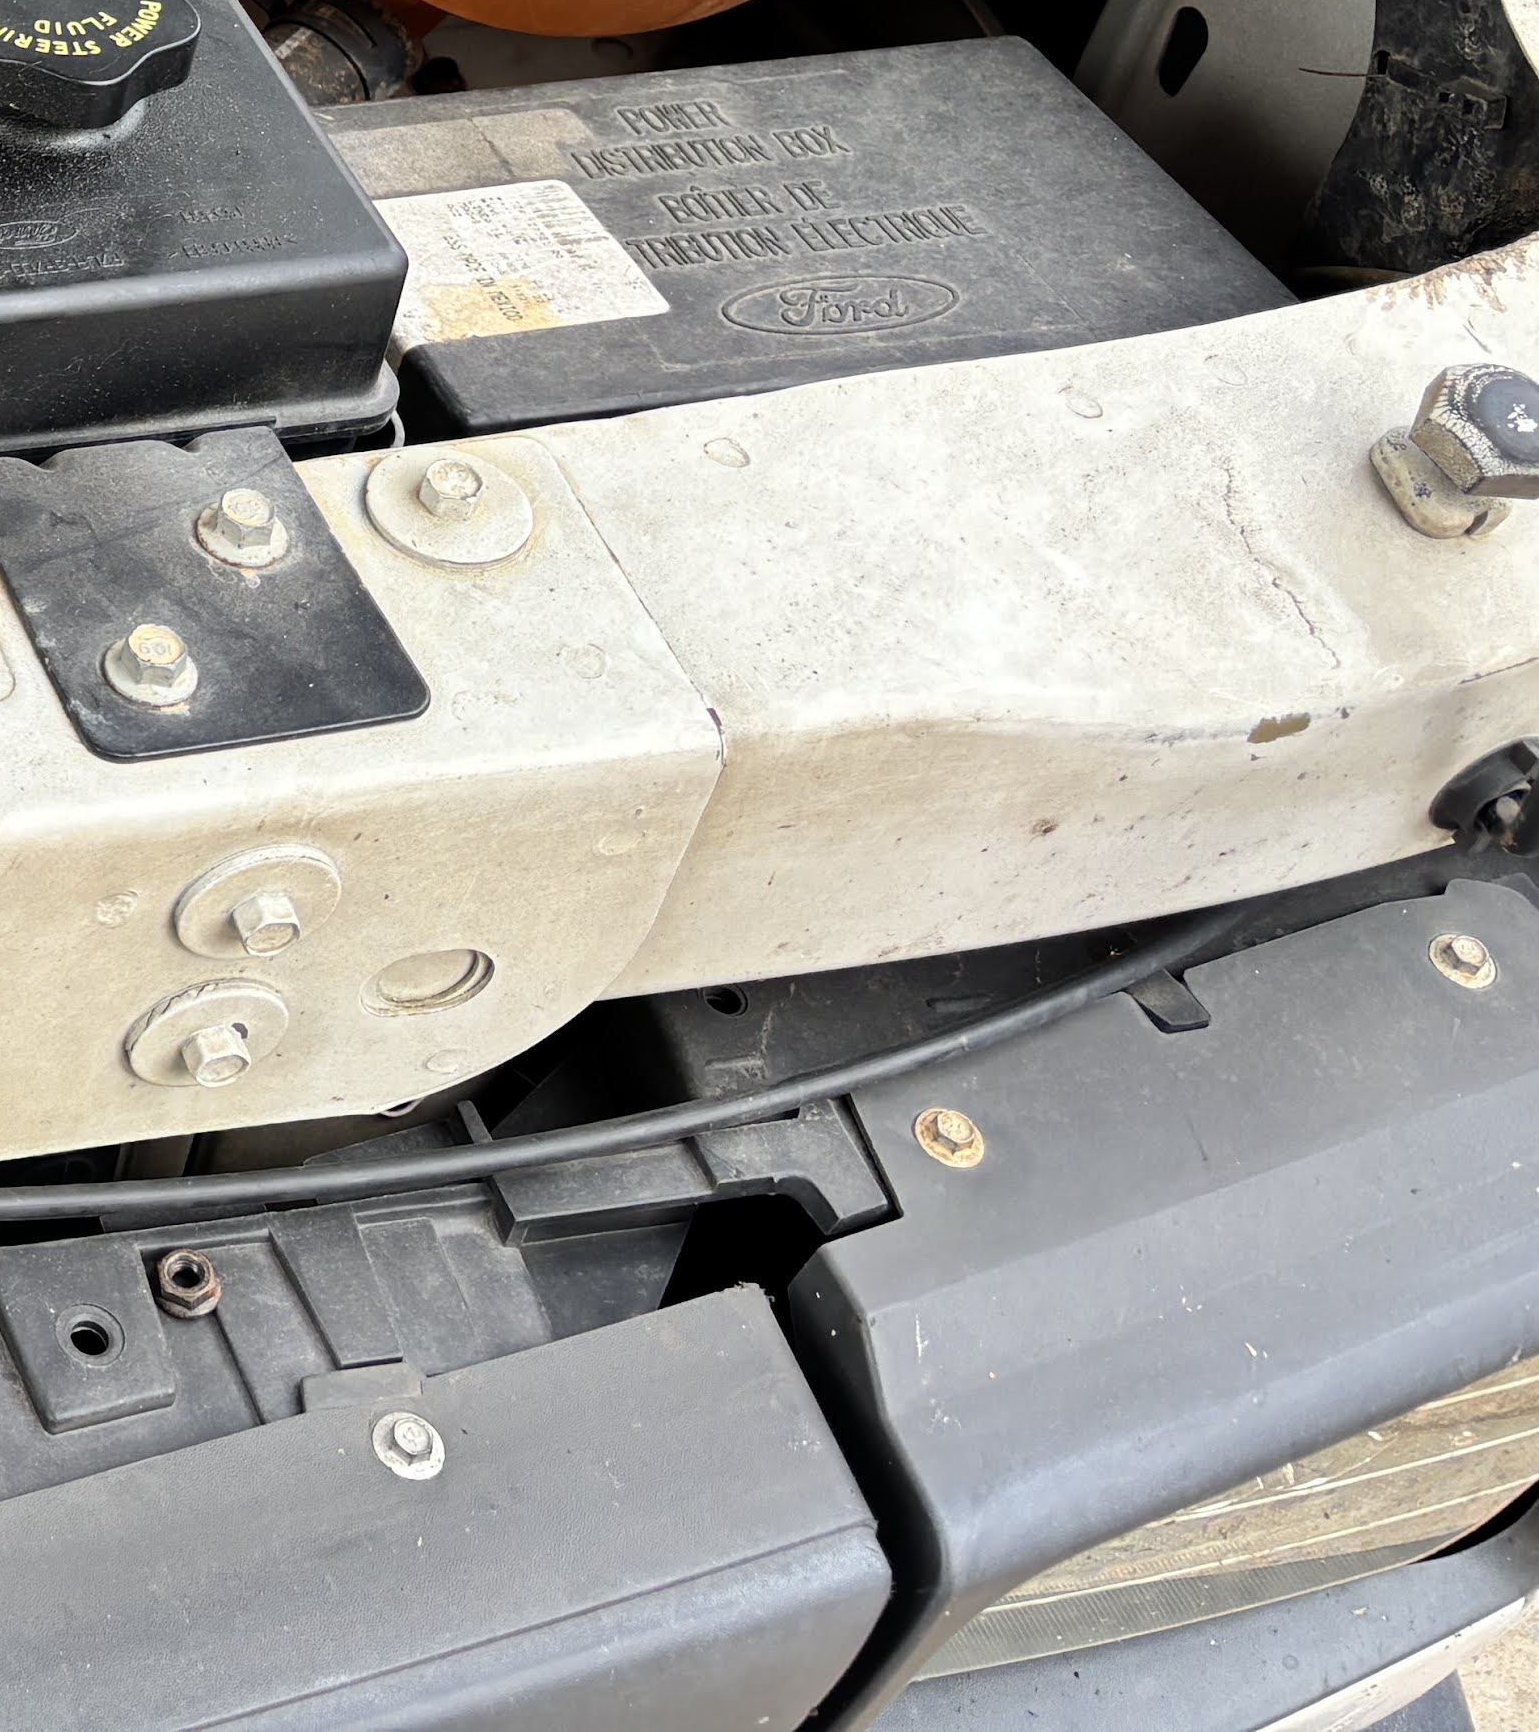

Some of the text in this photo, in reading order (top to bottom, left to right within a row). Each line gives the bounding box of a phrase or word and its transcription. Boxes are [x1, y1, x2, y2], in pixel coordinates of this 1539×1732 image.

[34, 11, 117, 36] FLUID
[108, 0, 163, 49] POWER
[617, 99, 730, 137] POWER
[570, 124, 851, 180] DISTRIBUTION BOX
[657, 179, 843, 225] BOÎTIER DE
[625, 204, 988, 269] TRIBUTION ÉLECTRIQUE
